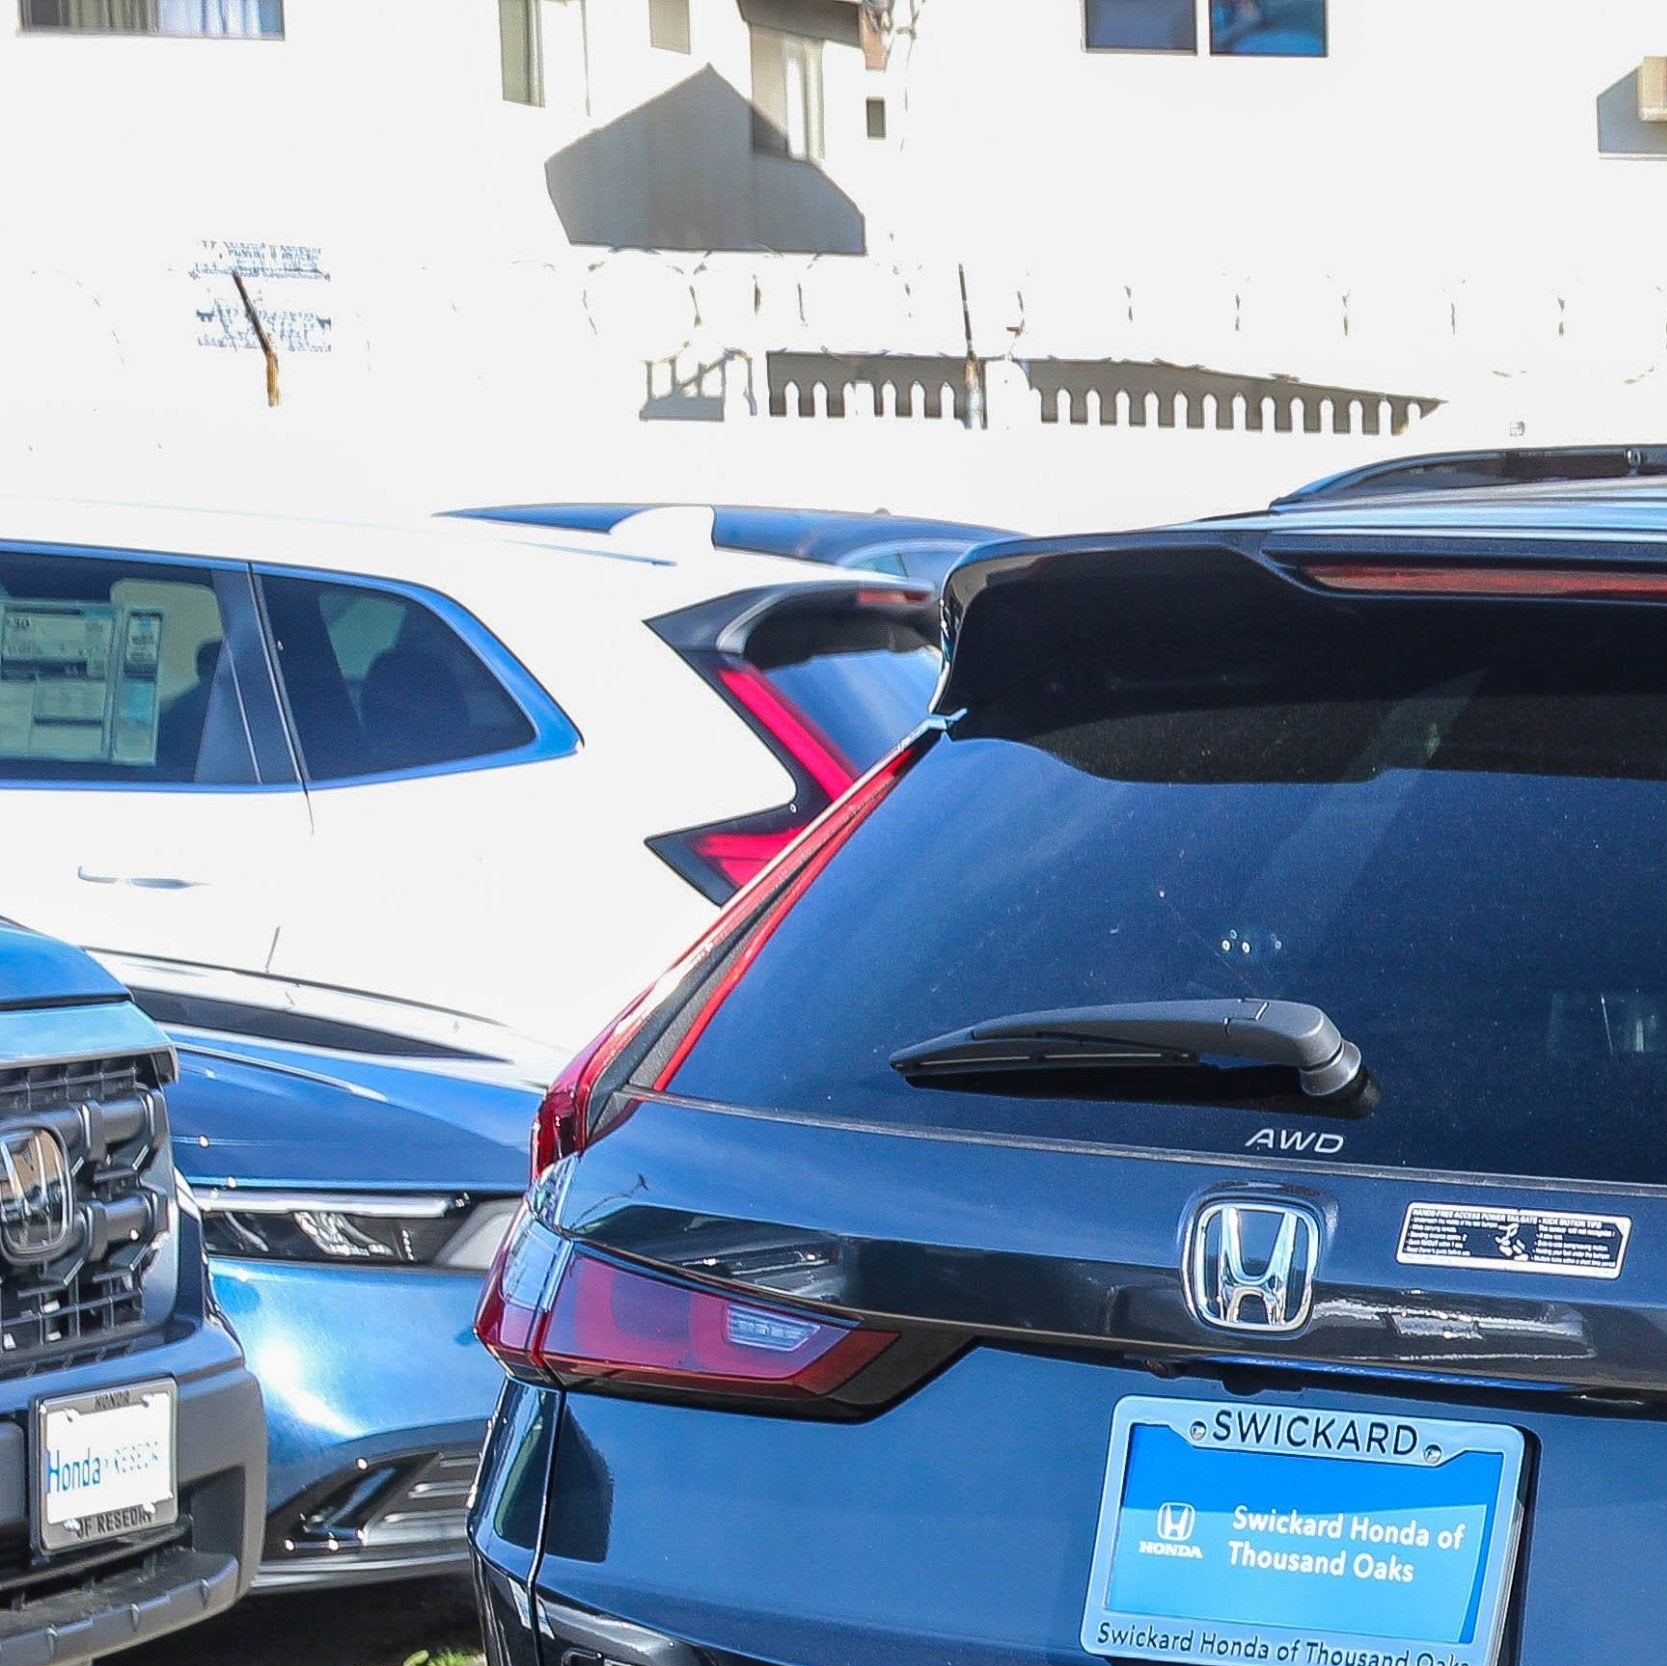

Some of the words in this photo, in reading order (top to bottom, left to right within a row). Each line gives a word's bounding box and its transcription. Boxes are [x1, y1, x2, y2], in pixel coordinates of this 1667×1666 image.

[1244, 1128, 1344, 1154] AWD
[1212, 1409, 1418, 1456] SWICKARD
[45, 1447, 101, 1494] Honda
[1232, 1504, 1344, 1539] Swickard
[1350, 1515, 1430, 1547] Honda
[1437, 1523, 1466, 1550] of
[1138, 1540, 1204, 1559] HONDA
[1228, 1540, 1347, 1576] Thousand
[1353, 1552, 1415, 1583] Oaks
[1097, 1622, 1194, 1652] Swickard
[1200, 1631, 1269, 1660] Honda
[1277, 1639, 1301, 1662] of
